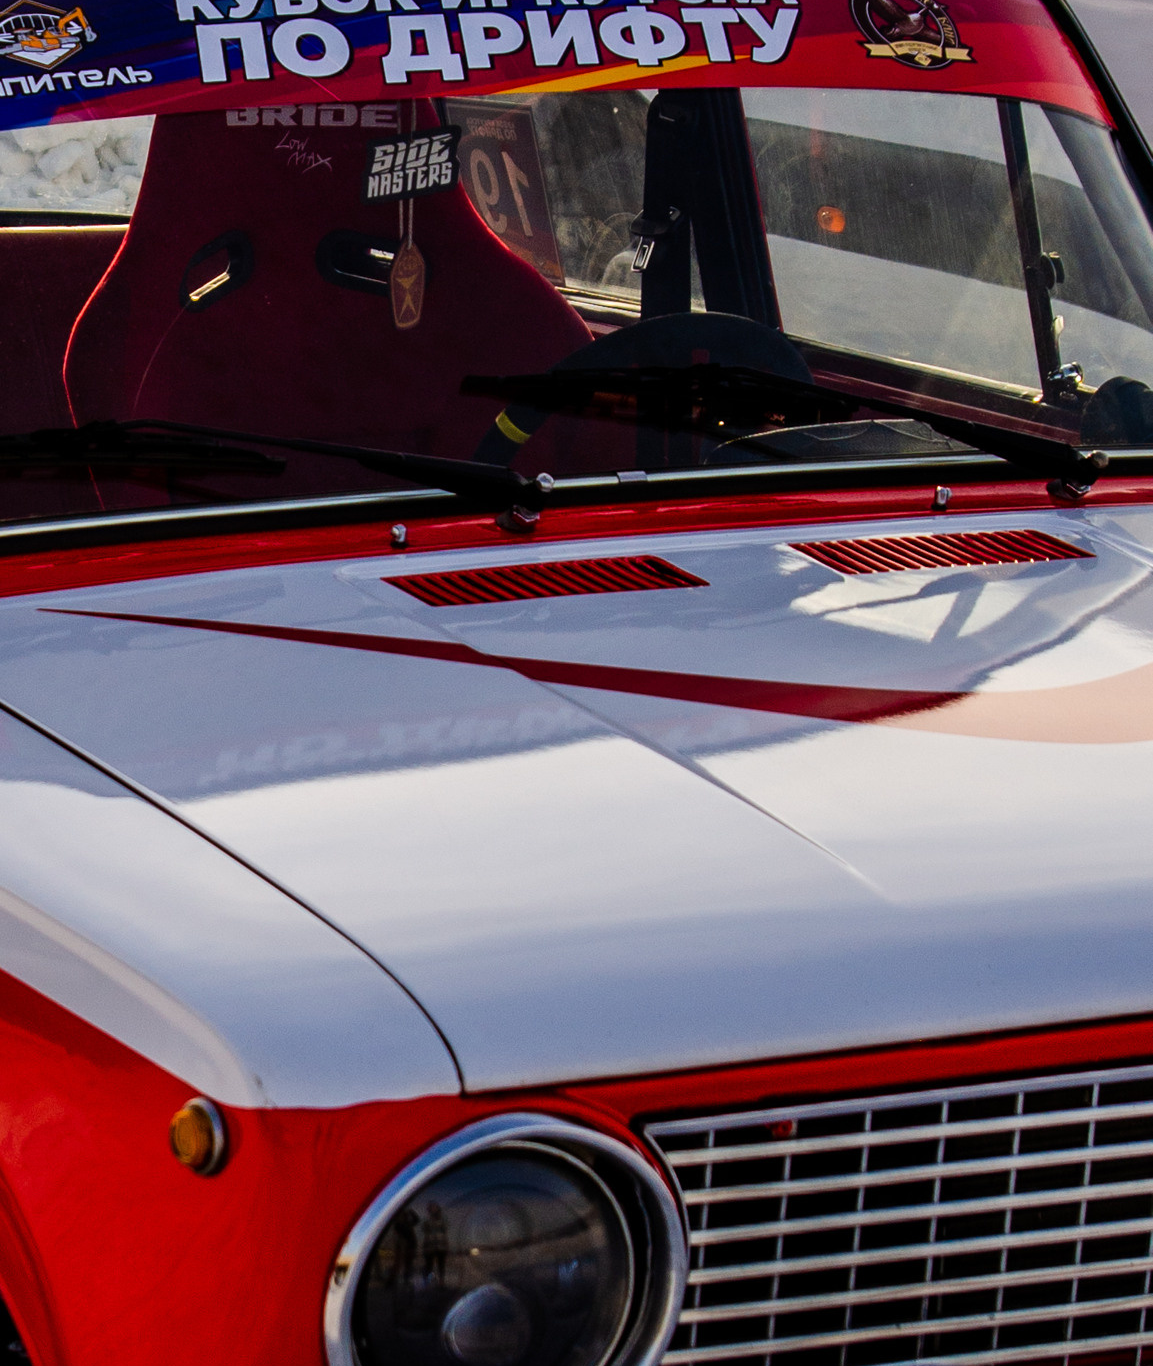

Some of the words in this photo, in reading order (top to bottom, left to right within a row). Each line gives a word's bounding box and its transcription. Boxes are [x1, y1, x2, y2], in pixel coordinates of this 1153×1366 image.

[194, 17, 351, 84] ПО
[382, 8, 800, 84] ДРИФТУ
[225, 104, 398, 127] BRIDE
[371, 133, 452, 174] SIDE
